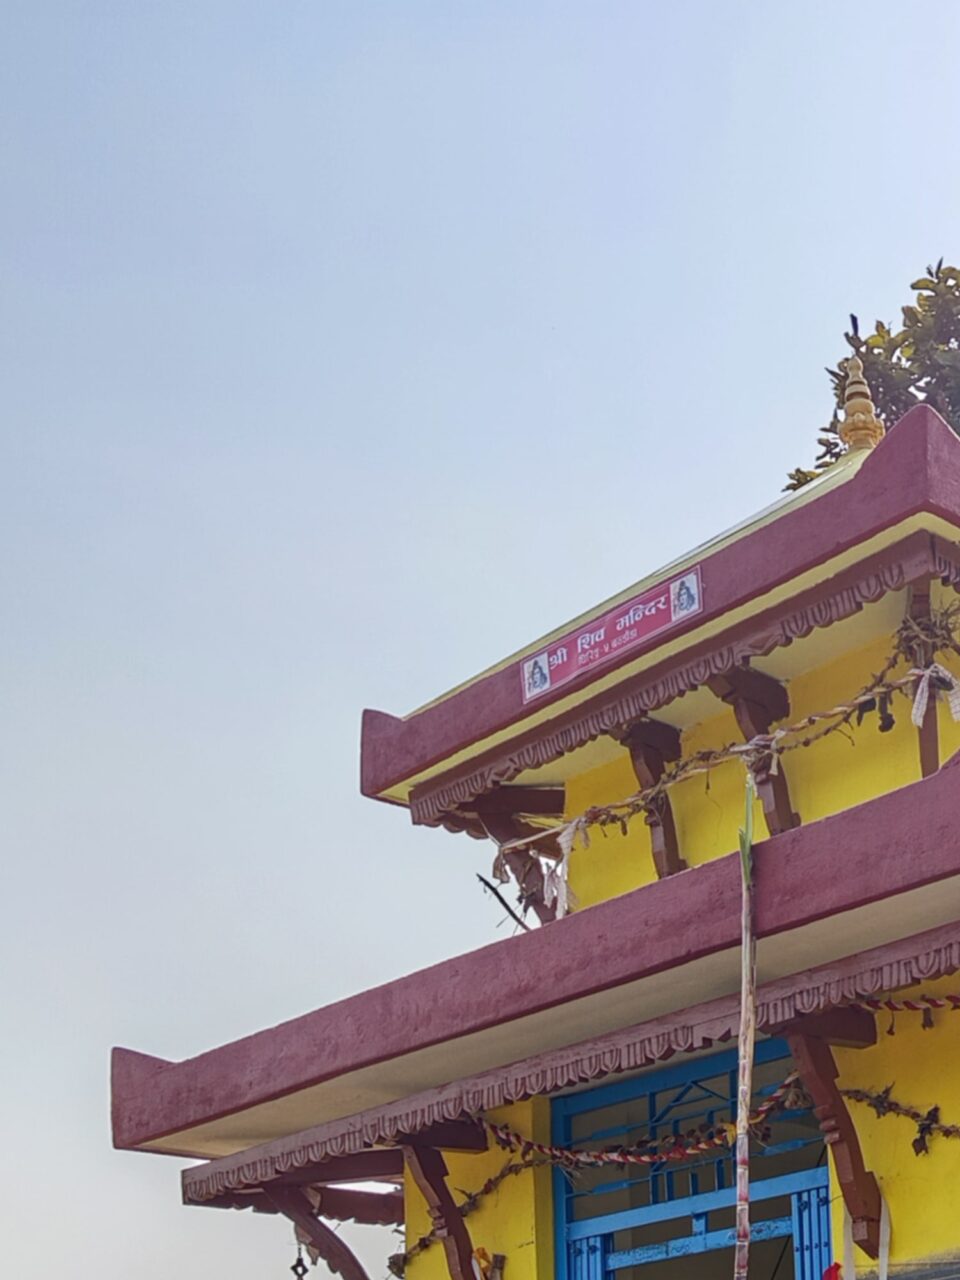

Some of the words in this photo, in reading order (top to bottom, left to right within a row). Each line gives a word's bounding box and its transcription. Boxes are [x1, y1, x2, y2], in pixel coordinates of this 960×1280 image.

[549, 648, 568, 670] श्री
[577, 627, 606, 653] शिव
[616, 593, 669, 631] मन्दिर
